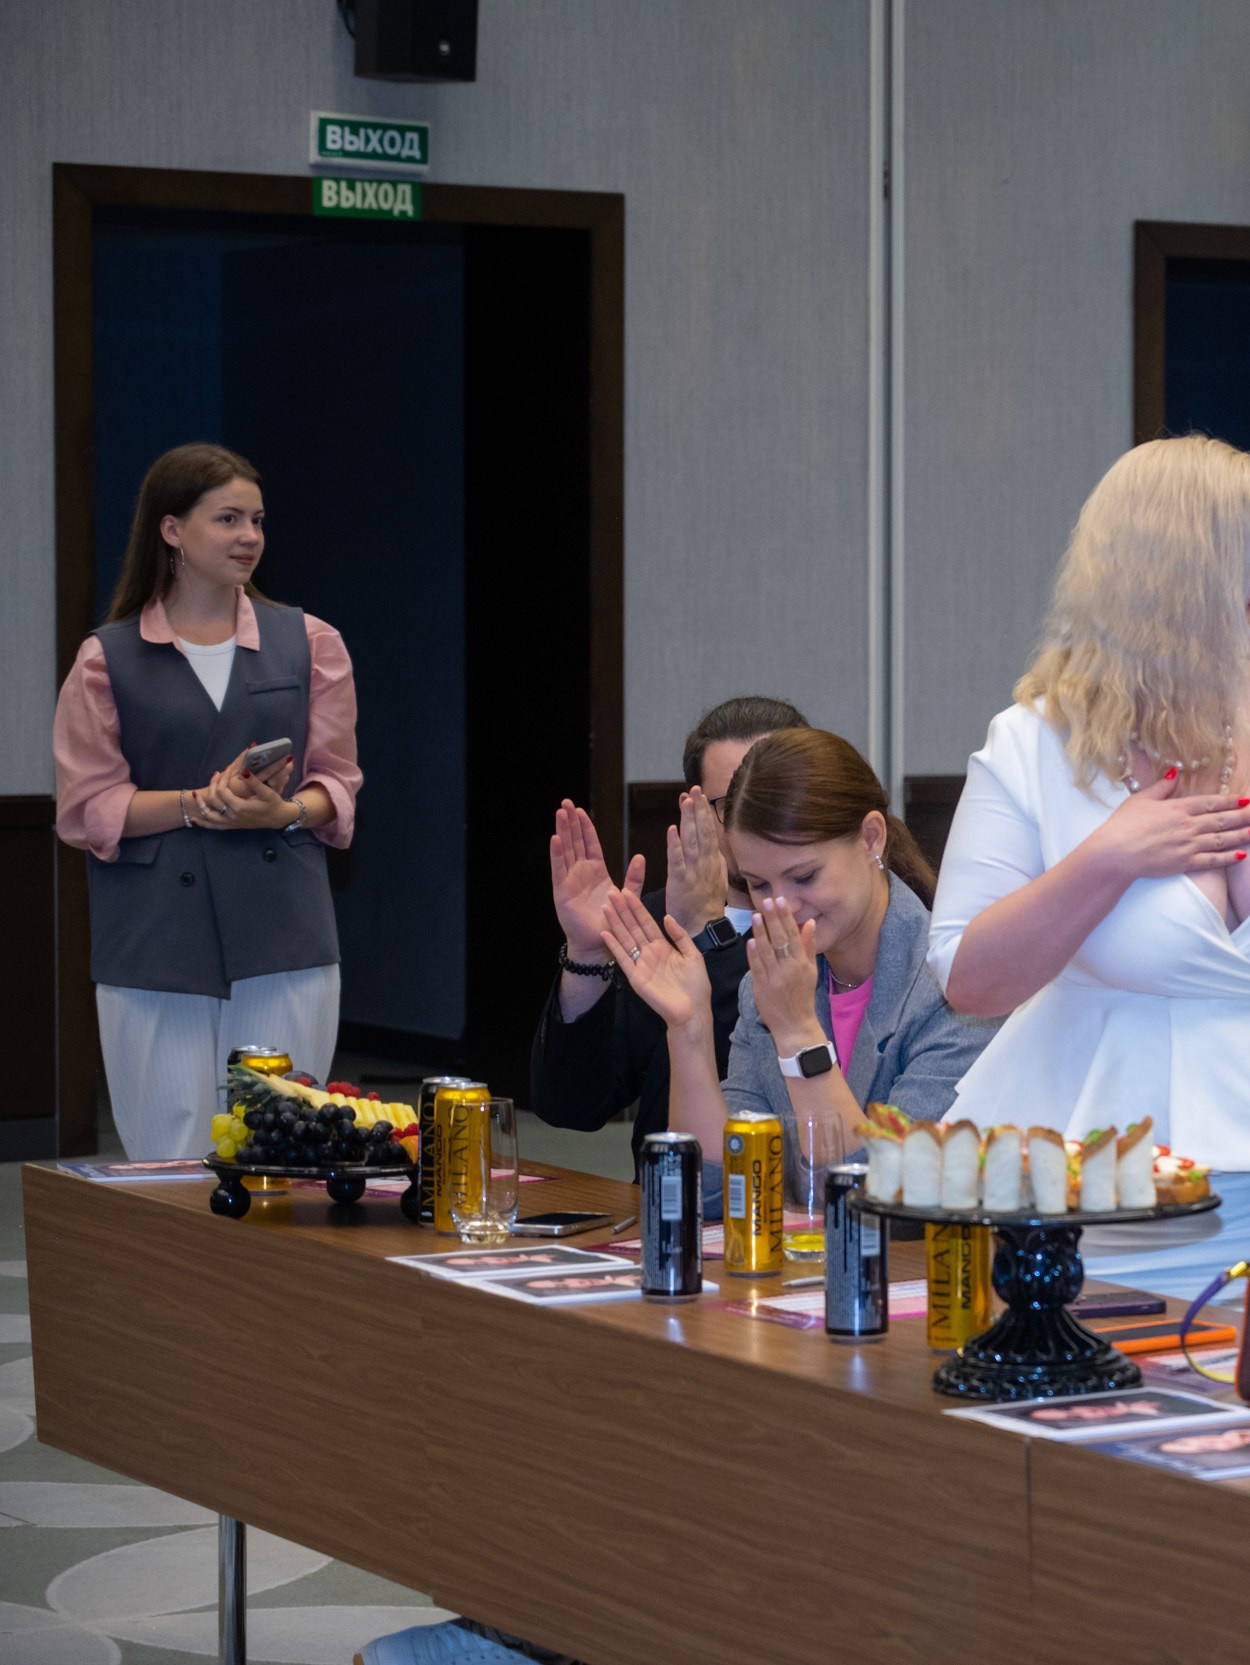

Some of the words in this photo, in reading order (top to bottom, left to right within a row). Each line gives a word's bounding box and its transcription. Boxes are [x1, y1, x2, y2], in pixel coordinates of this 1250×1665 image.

[326, 125, 421, 159] ВЫХОД
[322, 179, 414, 217] ВЫХОД
[423, 1102, 435, 1208] MILANO
[453, 1104, 470, 1209] MILANO
[752, 1159, 762, 1236] MANGO
[768, 1135, 783, 1253] MILANO
[932, 1224, 951, 1329] MILAN
[961, 1224, 971, 1309] MANGO
